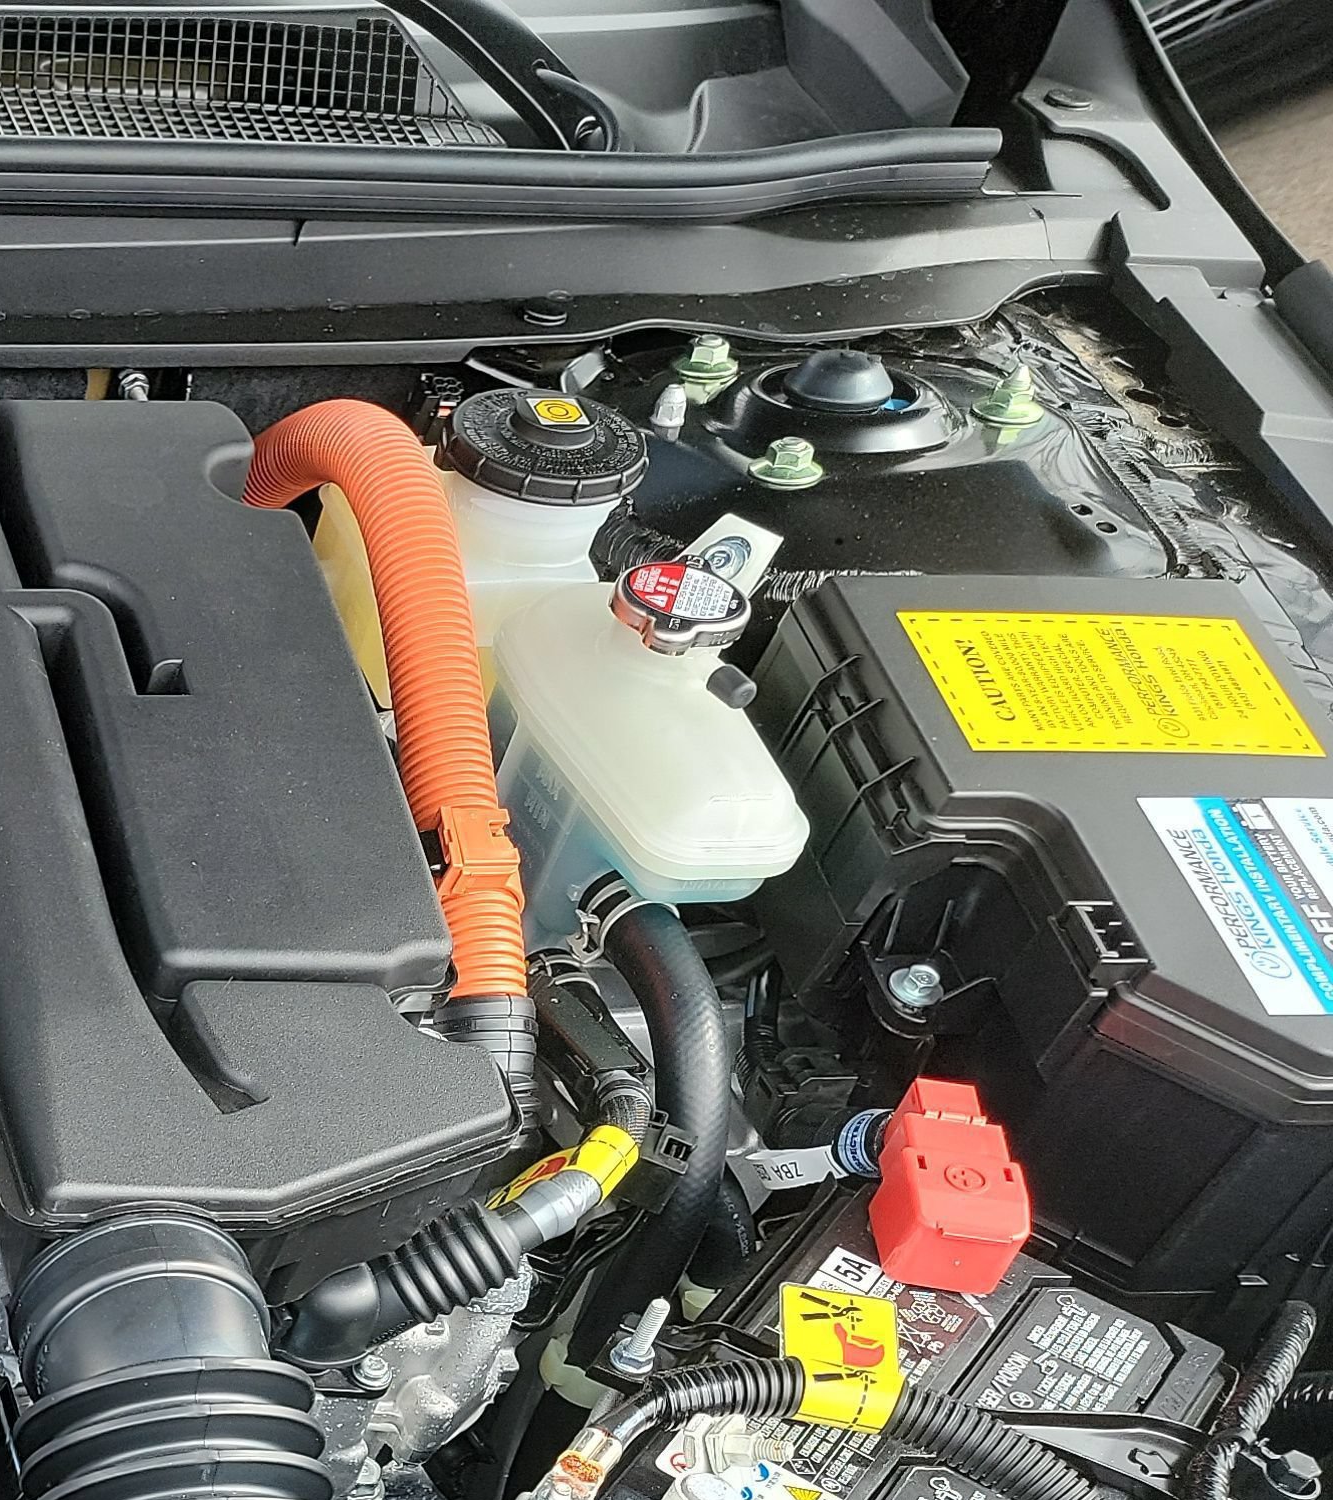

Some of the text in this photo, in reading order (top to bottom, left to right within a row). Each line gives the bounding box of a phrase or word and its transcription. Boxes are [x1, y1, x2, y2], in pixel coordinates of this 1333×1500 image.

[978, 630, 1007, 665] COVERED
[993, 633, 1011, 650] MILE
[1006, 632, 1023, 648] THIS
[1017, 631, 1037, 649] WITH
[1032, 634, 1052, 653] TECH
[1029, 651, 1060, 688] EQUIPPED
[1045, 655, 1064, 673] HIGH
[1050, 642, 1077, 673] SPECIAL
[1094, 627, 1163, 715] PERFORMANCE
[1112, 627, 1180, 716] KINGS Honda
[951, 638, 1019, 720] CAUTION!
[1057, 633, 1124, 729] TRAINING AND TOOLS ARE
[1057, 675, 1081, 701] BOARD
[1095, 673, 1109, 682] TO
[1009, 683, 1031, 706] PARTS
[1074, 703, 1089, 714] ON
[1102, 685, 1134, 723] REQUIRED
[1218, 684, 1241, 707] HOUR
[1024, 708, 1045, 730] MANY
[1042, 695, 1071, 729] FACTORY
[1057, 698, 1086, 731] VEHICLE
[1253, 832, 1290, 872] BATTERY
[1268, 833, 1321, 899] REPLACEMENT
[1166, 828, 1256, 949] PERFORMANCE
[1187, 828, 1276, 948] KINGS Honda
[1207, 806, 1333, 1000] COMPLIMENTARY INSTALLATION
[770, 1161, 804, 1181] ZBA
[927, 1341, 945, 1354] Pb
